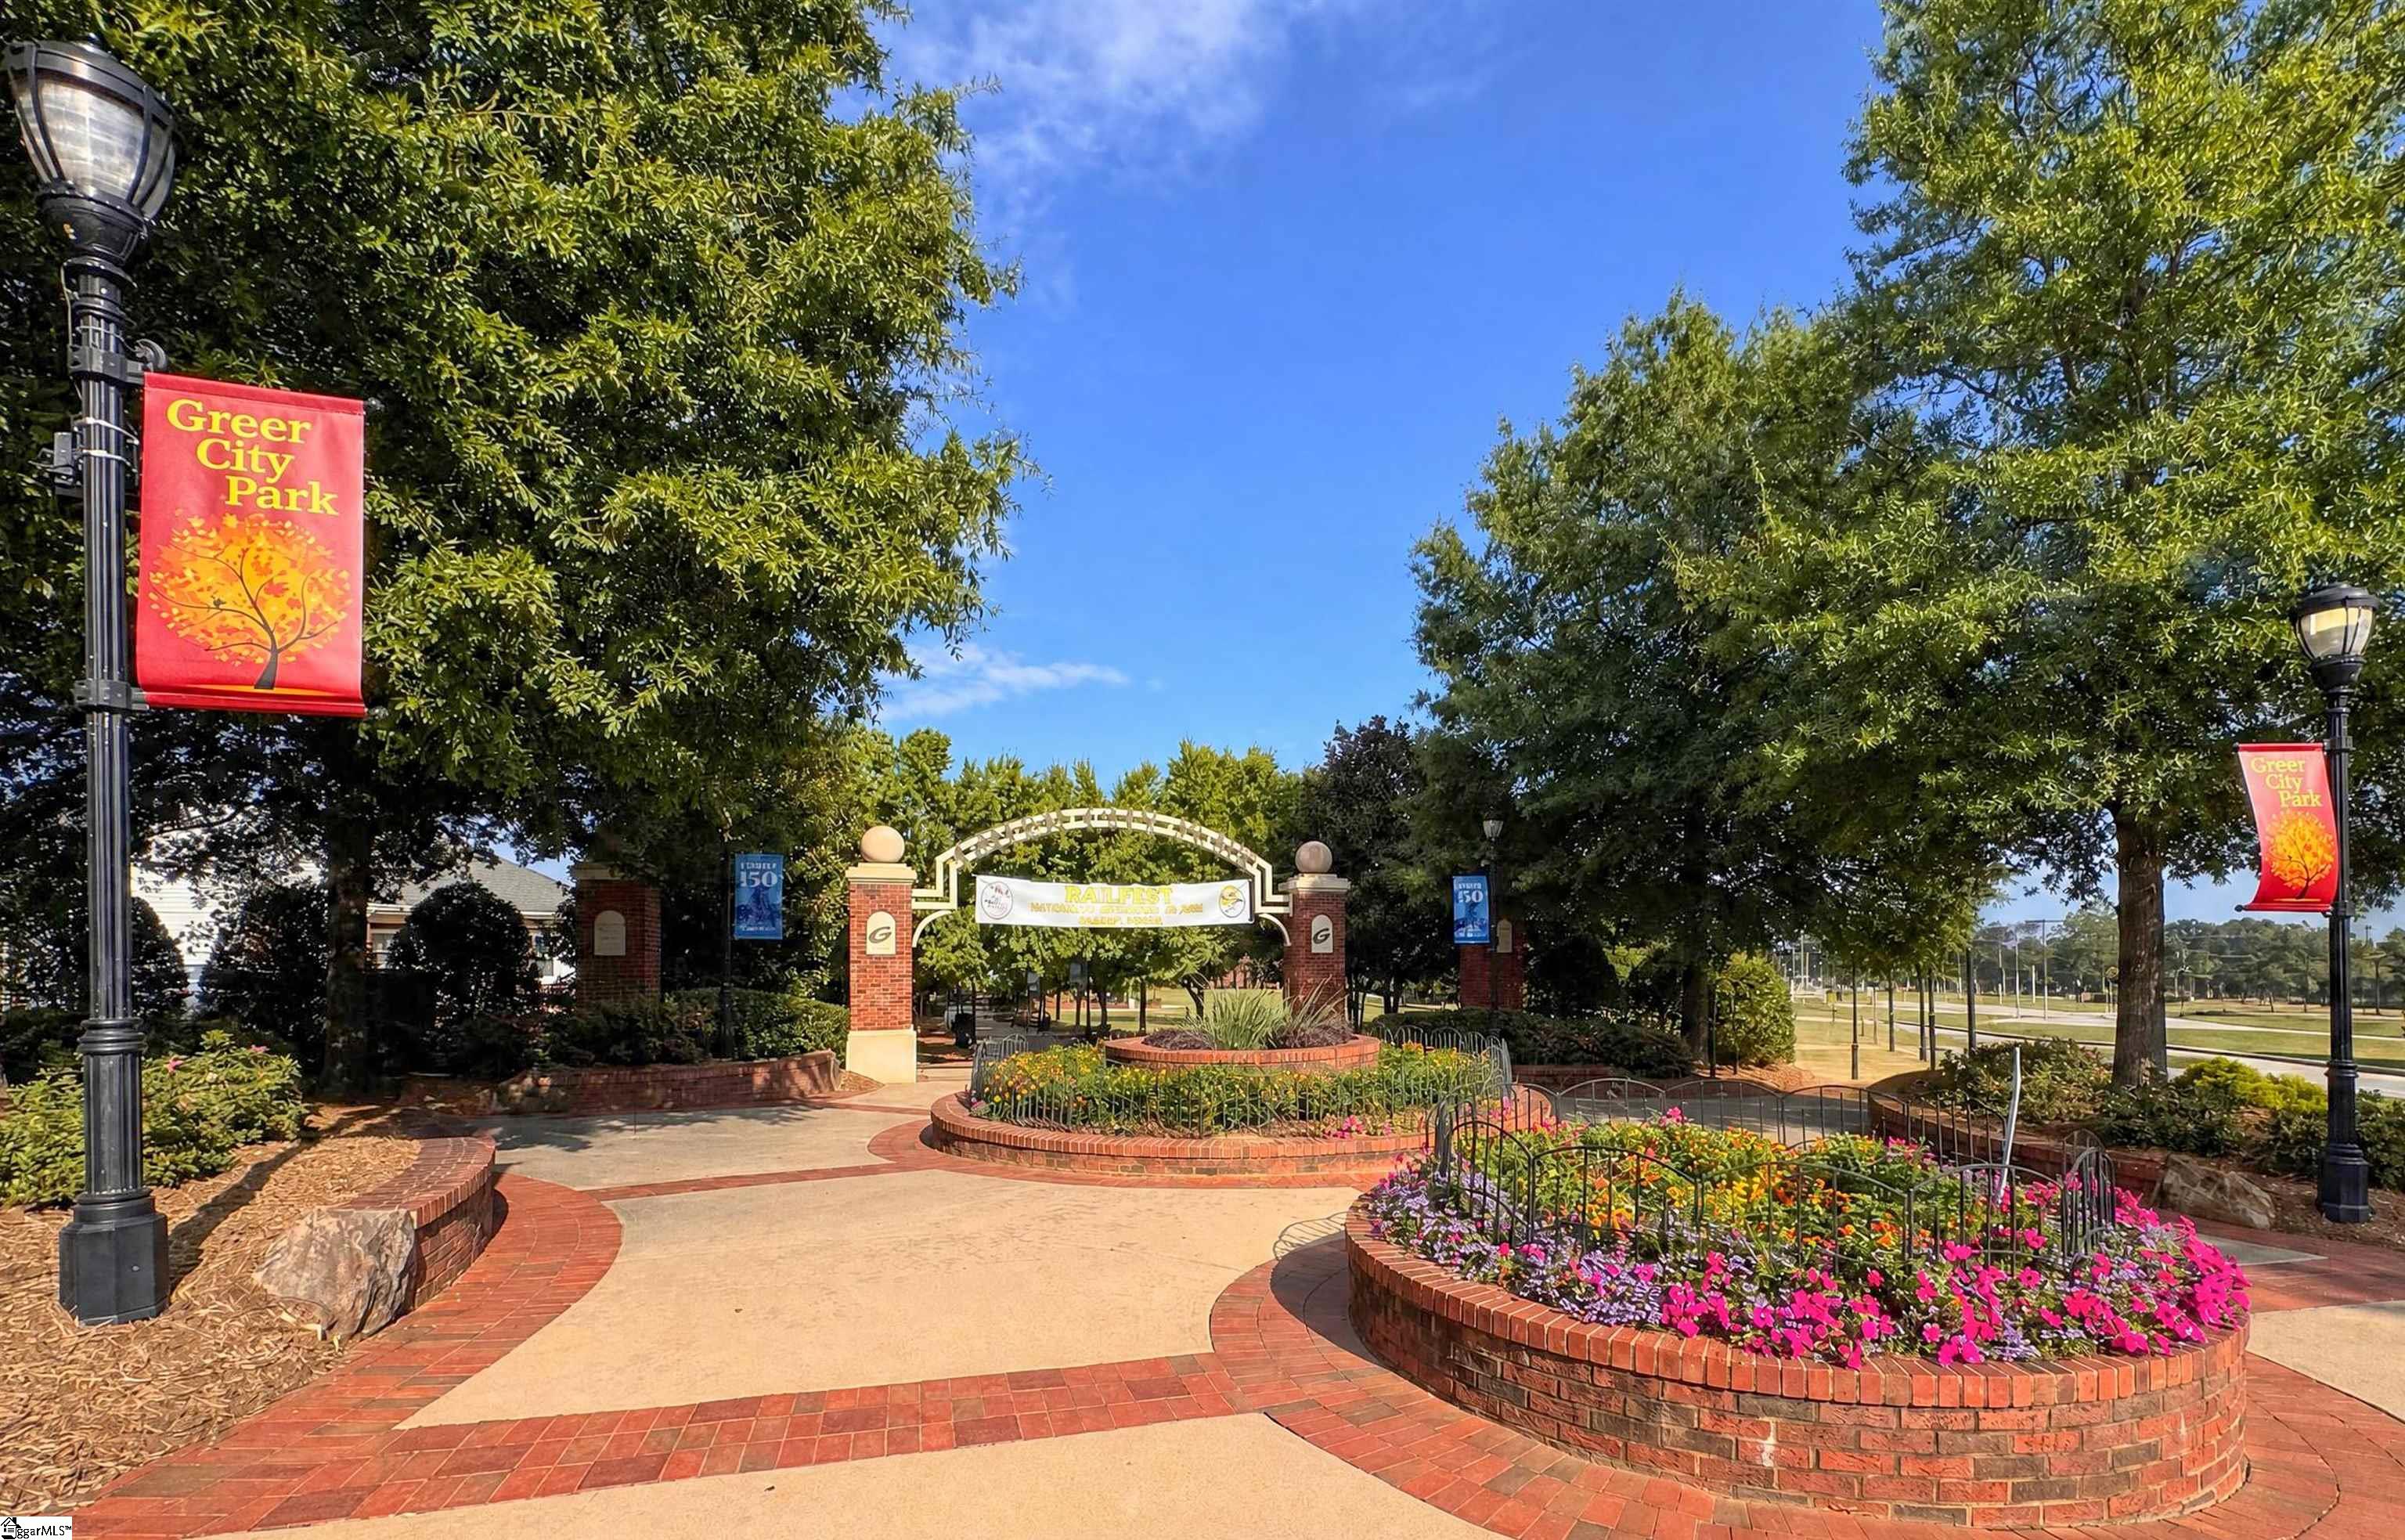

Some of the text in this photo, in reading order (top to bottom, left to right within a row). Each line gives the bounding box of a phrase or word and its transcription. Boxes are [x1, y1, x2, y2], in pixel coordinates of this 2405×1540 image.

[166, 398, 313, 444] Greer
[196, 437, 295, 483] City
[224, 474, 339, 516] Park
[2250, 756, 2306, 774] Greer
[2265, 774, 2304, 792] City
[2279, 789, 2323, 808] Park
[740, 871, 778, 888] 150
[1064, 885, 1174, 904] RAILFEST
[1457, 889, 1484, 903] 150
[868, 926, 892, 944] G
[1313, 928, 1331, 944] G
